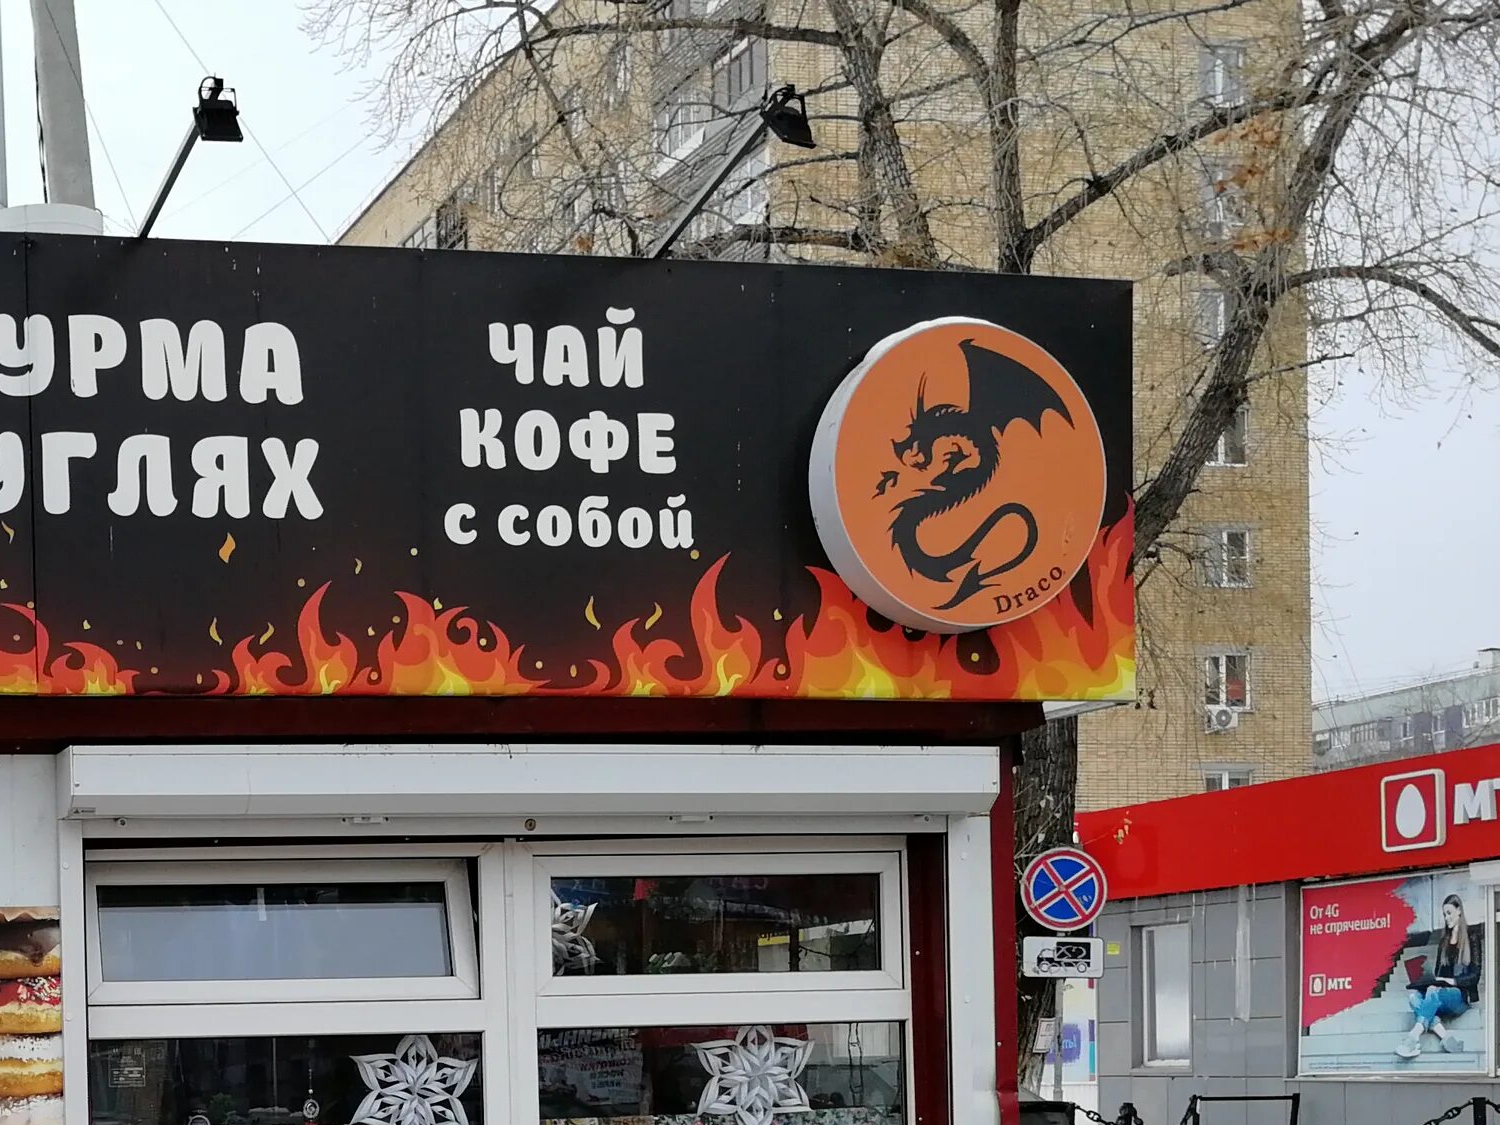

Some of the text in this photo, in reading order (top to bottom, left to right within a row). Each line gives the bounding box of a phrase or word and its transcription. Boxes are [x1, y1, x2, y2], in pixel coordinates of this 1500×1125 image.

[488, 306, 644, 389] ЧАЙ
[459, 407, 677, 474] КОФЕ
[444, 493, 695, 550] с собой
[993, 566, 1064, 614] Draco
[1309, 903, 1340, 920] От 4G
[1309, 912, 1391, 936] не спрячешься!
[1327, 976, 1353, 991] МТС
